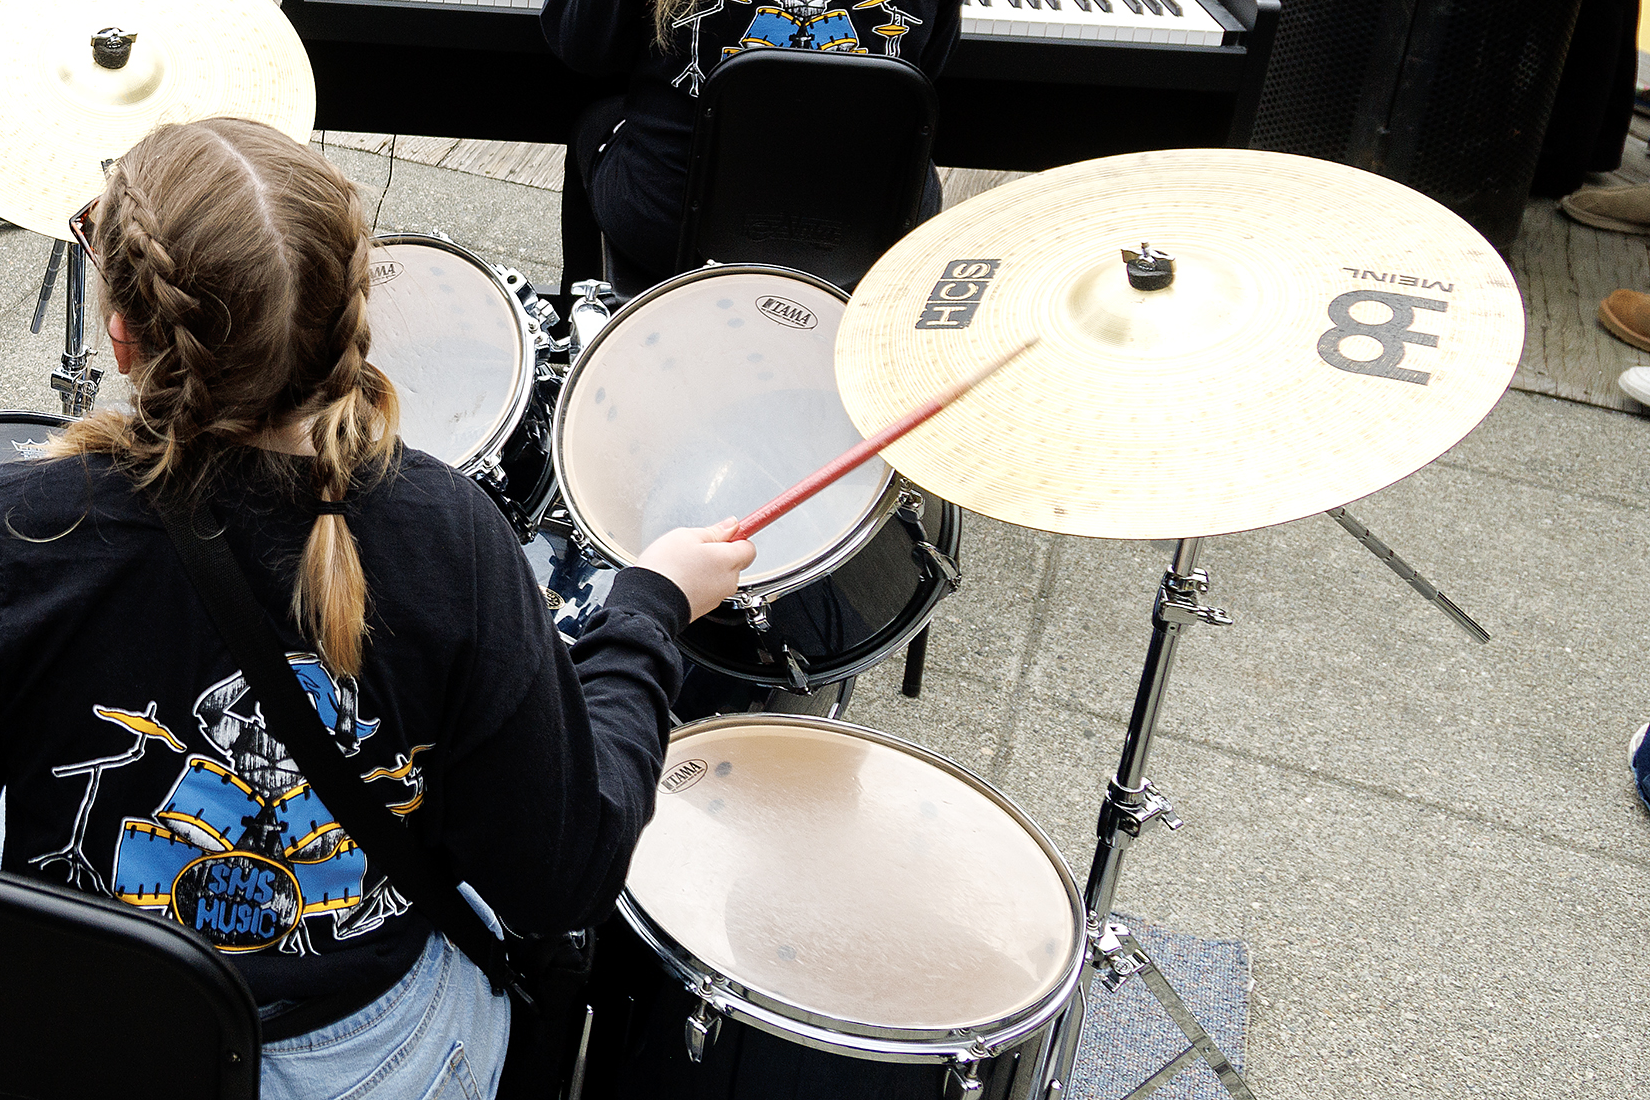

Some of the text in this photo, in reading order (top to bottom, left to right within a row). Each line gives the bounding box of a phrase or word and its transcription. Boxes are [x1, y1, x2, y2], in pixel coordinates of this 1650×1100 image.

[368, 263, 396, 279] AMA
[1342, 267, 1455, 293] MEINL
[916, 259, 1001, 329] HCS
[771, 300, 812, 325] TAMA
[666, 761, 702, 786] TAMA
[208, 863, 276, 904] SMS
[195, 897, 277, 939] MUSIC
